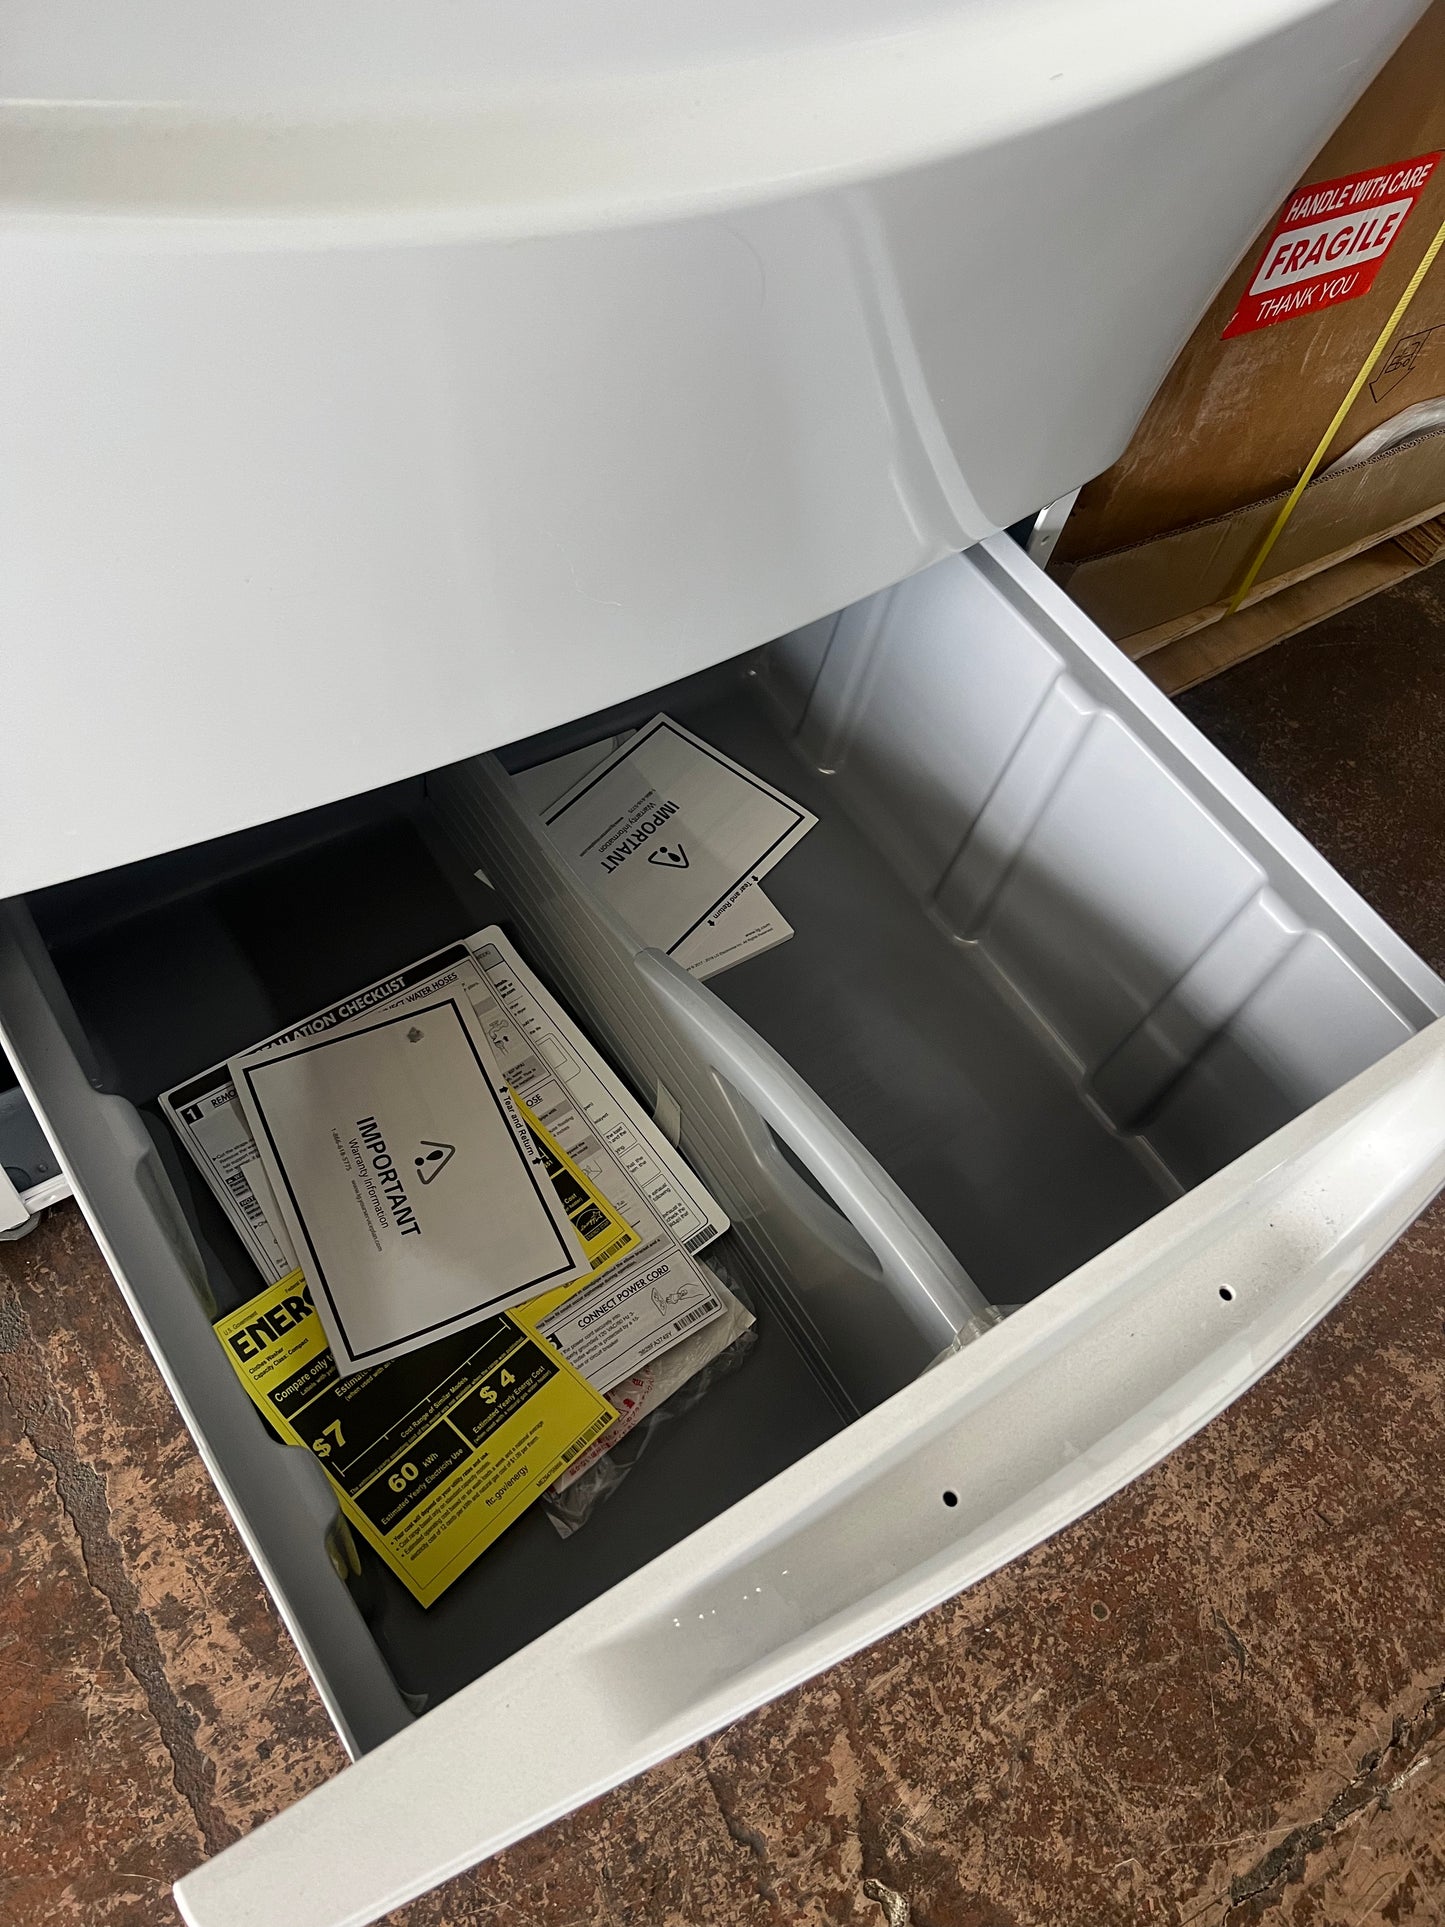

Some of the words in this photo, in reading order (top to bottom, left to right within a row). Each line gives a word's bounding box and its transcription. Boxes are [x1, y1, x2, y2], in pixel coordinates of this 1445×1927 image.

[1284, 185, 1353, 223] HANDLE
[1350, 174, 1388, 205] WITH
[1389, 163, 1434, 196] CARE
[1264, 212, 1400, 280] FRAGILE
[1256, 284, 1319, 322] THANK
[1319, 272, 1360, 303] YOU
[628, 802, 656, 825] Warranty
[598, 824, 632, 853] Information
[600, 800, 680, 874] IMPORTANT
[713, 901, 732, 919] Return
[338, 976, 405, 1017] CHECKLIST
[431, 972, 457, 990] HOSES
[518, 1129, 534, 1156] Return
[348, 1138, 368, 1177] Warranty
[364, 1178, 389, 1229] Information
[356, 1116, 421, 1235] IMPORTANT
[577, 1299, 617, 1328] CONNECT
[616, 1278, 648, 1301] POWER
[646, 1264, 669, 1282] CORD
[578, 1336, 599, 1353] grounded
[603, 1327, 623, 1344] protected
[249, 1360, 267, 1374] Clothes
[265, 1347, 284, 1362] Washer
[253, 1365, 274, 1381] Capacity
[288, 1338, 309, 1355] Compact
[274, 1374, 310, 1402] Compare
[310, 1359, 328, 1375] only
[412, 1412, 429, 1428] Range
[433, 1392, 451, 1409] Similar
[449, 1377, 468, 1393] Models
[472, 1408, 500, 1434] Estimated
[497, 1394, 516, 1409] Yearly
[513, 1377, 533, 1395] Energy
[388, 1462, 419, 1492] 60
[422, 1453, 438, 1467] kWh
[381, 1498, 410, 1525] Estimated
[408, 1482, 427, 1499] Yearly
[425, 1458, 453, 1484] Electricity
[485, 1465, 528, 1507] ftc.gov/energy
[421, 1500, 437, 1517] depend
